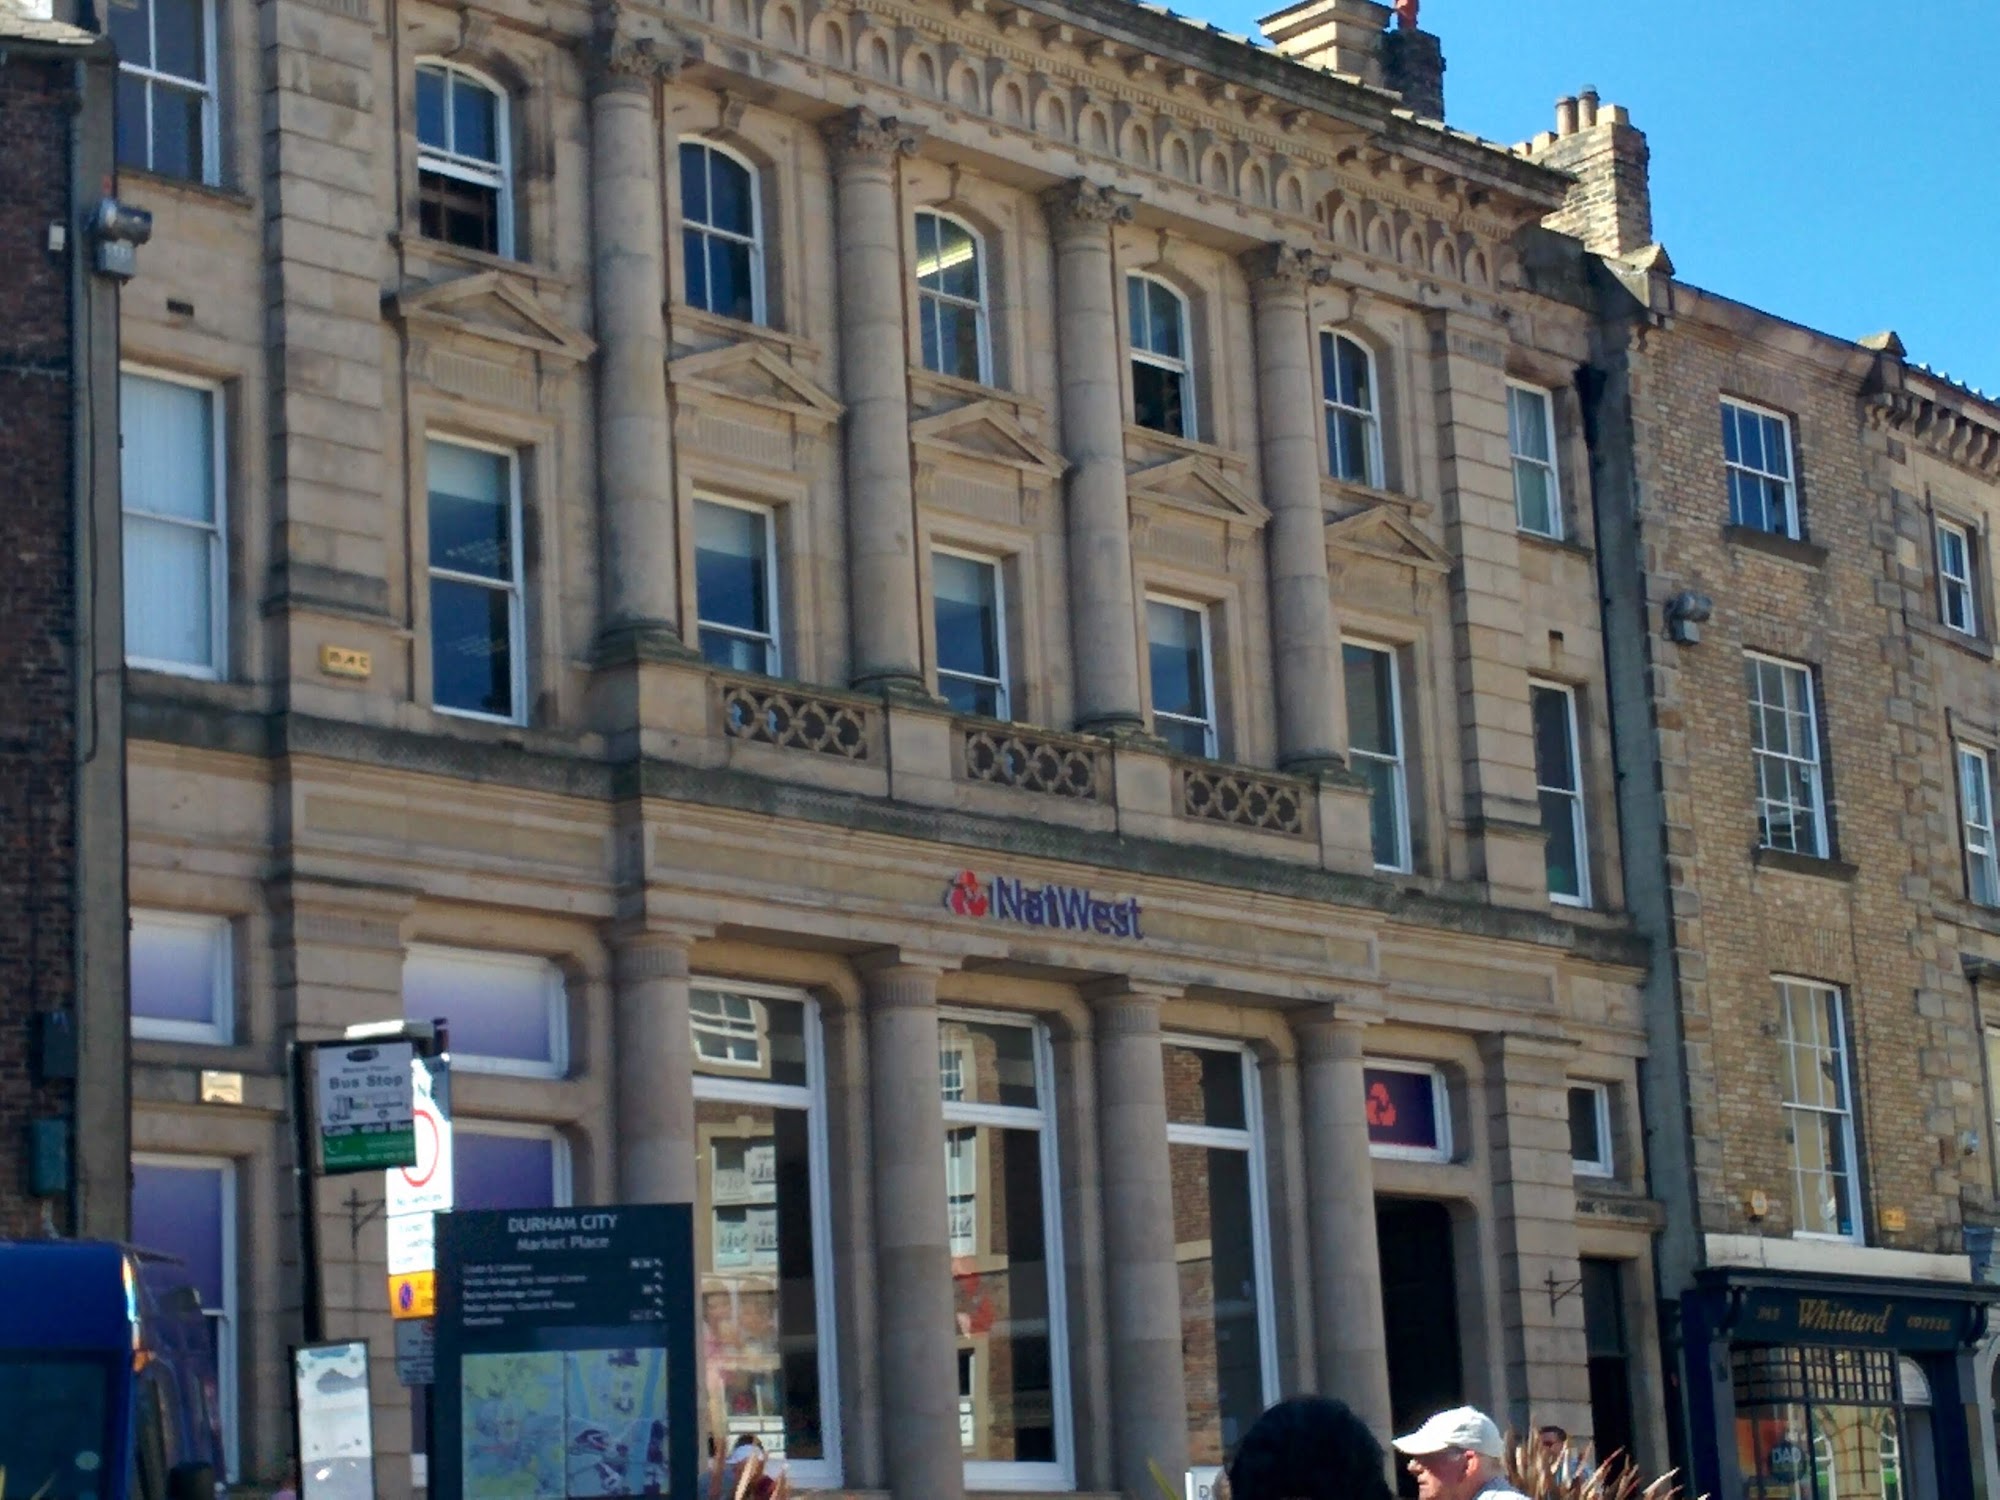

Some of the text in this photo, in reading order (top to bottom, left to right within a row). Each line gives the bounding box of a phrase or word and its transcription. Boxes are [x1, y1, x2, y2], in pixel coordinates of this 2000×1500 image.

[991, 877, 1143, 939] NatWest
[329, 1074, 403, 1090] Bus Stop
[508, 1214, 618, 1233] DURHAM CITY
[517, 1235, 610, 1250] Market Place
[1798, 1298, 1893, 1334] Whittard
